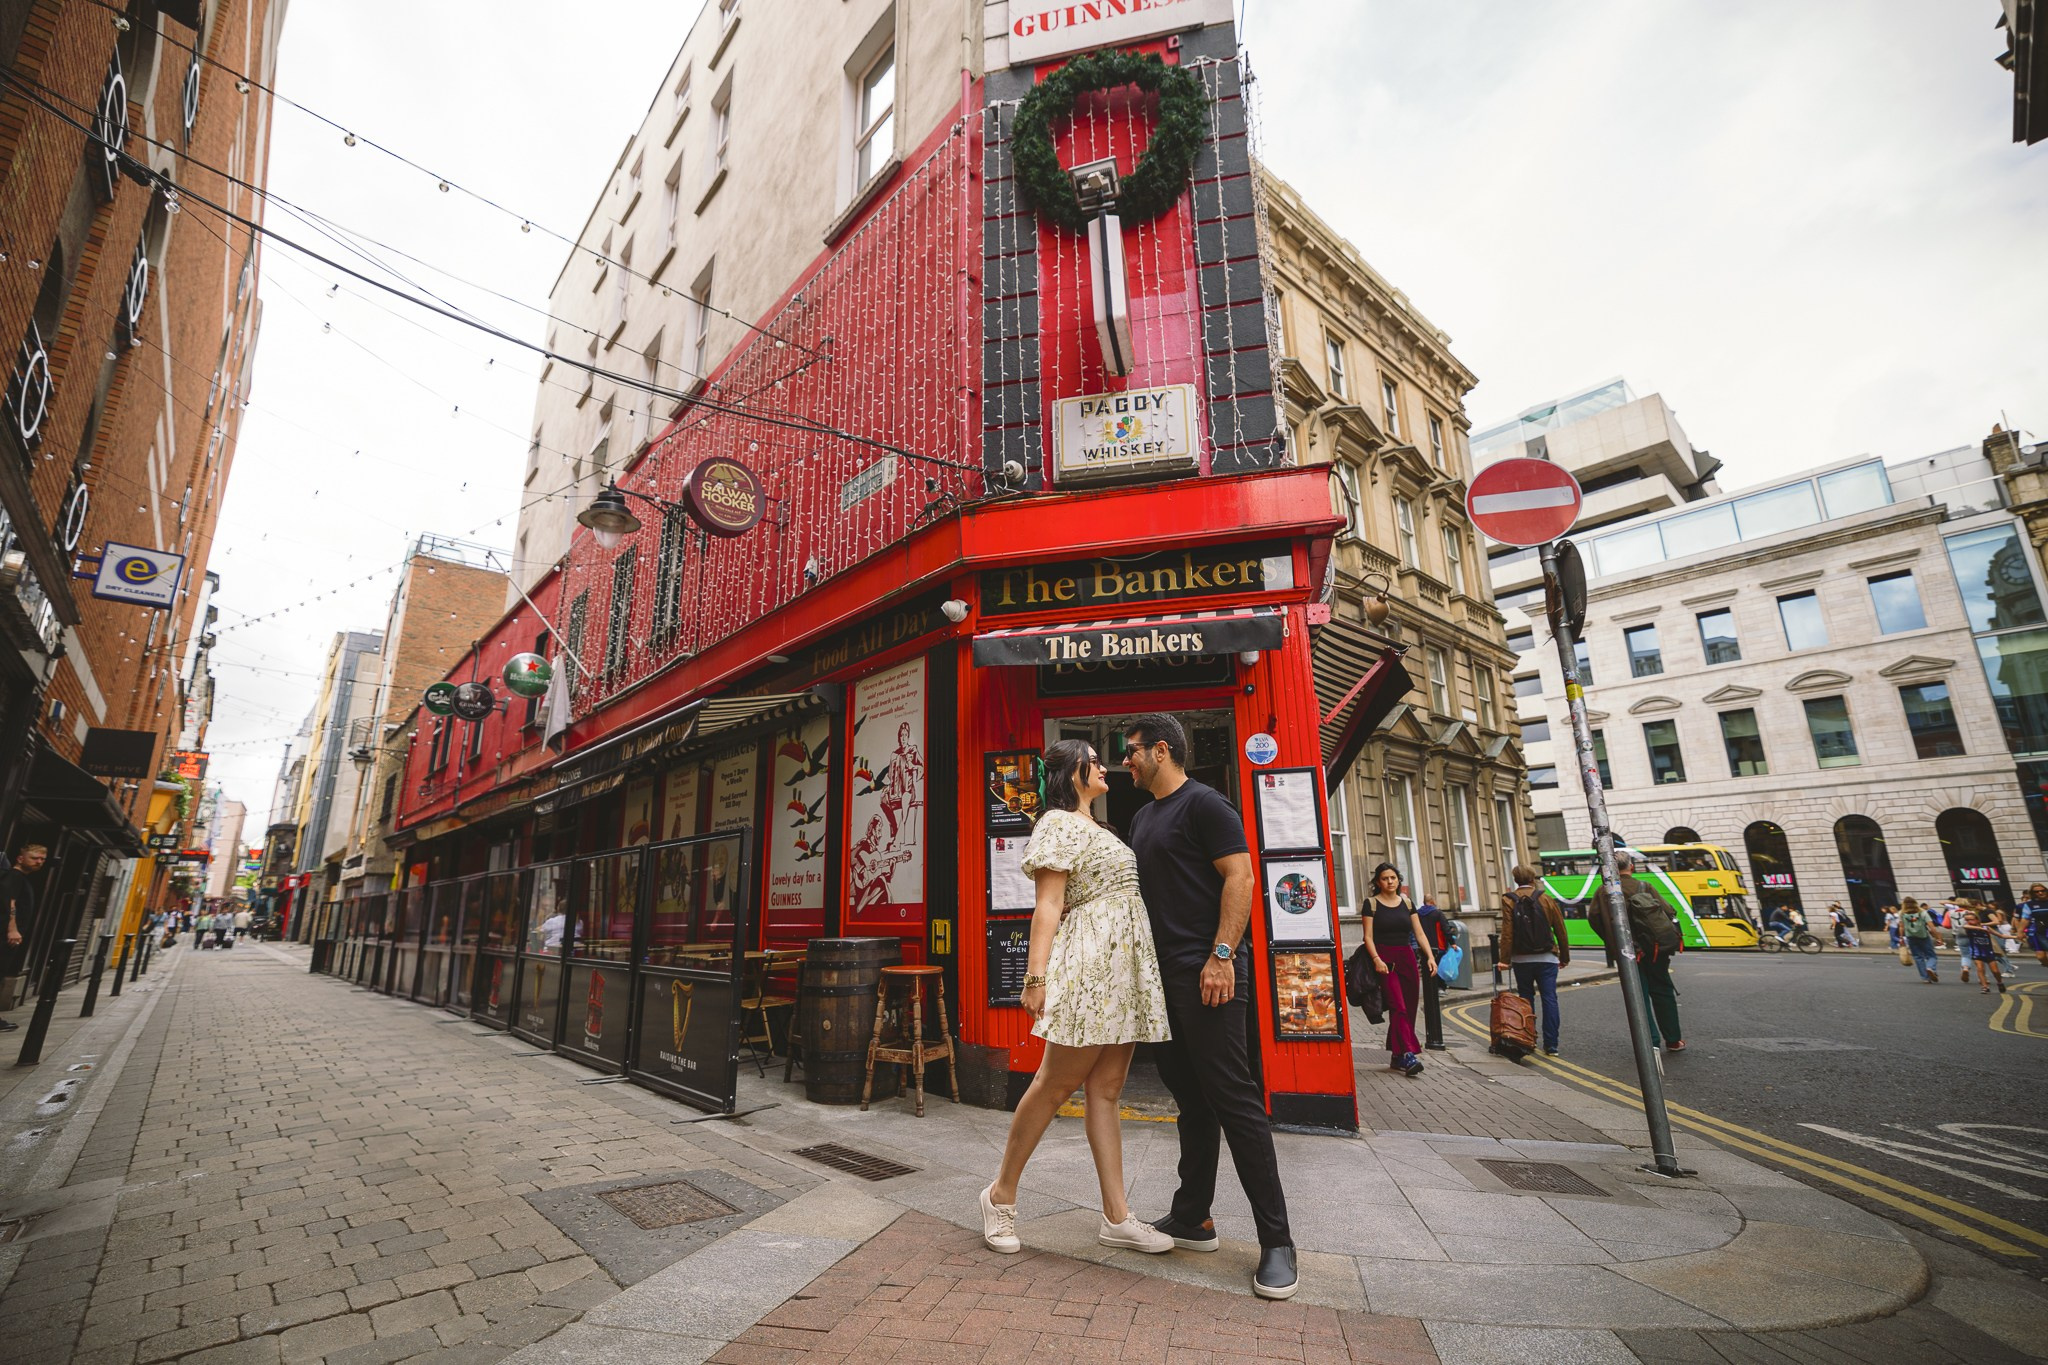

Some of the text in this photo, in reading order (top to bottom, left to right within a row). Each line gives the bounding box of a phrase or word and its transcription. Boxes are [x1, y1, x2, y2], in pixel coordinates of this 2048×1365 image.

[1013, 0, 1193, 37] GUINNE
[1080, 393, 1165, 418] PADDY
[1084, 441, 1164, 461] WHISKEY
[701, 489, 756, 514] HOOKER
[702, 481, 756, 503] GALWAY
[997, 566, 1076, 606] The
[1090, 551, 1279, 598] Bankers
[124, 587, 166, 598] CLEANERS
[811, 607, 929, 677] Food All Day
[1045, 628, 1204, 661] The Bankers
[621, 743, 634, 761] The
[88, 764, 109, 772] THE
[772, 870, 821, 887] Lovely day for a
[771, 891, 802, 906] GUINNESS
[678, 1056, 687, 1067] THE
[687, 1059, 697, 1070] BAR
